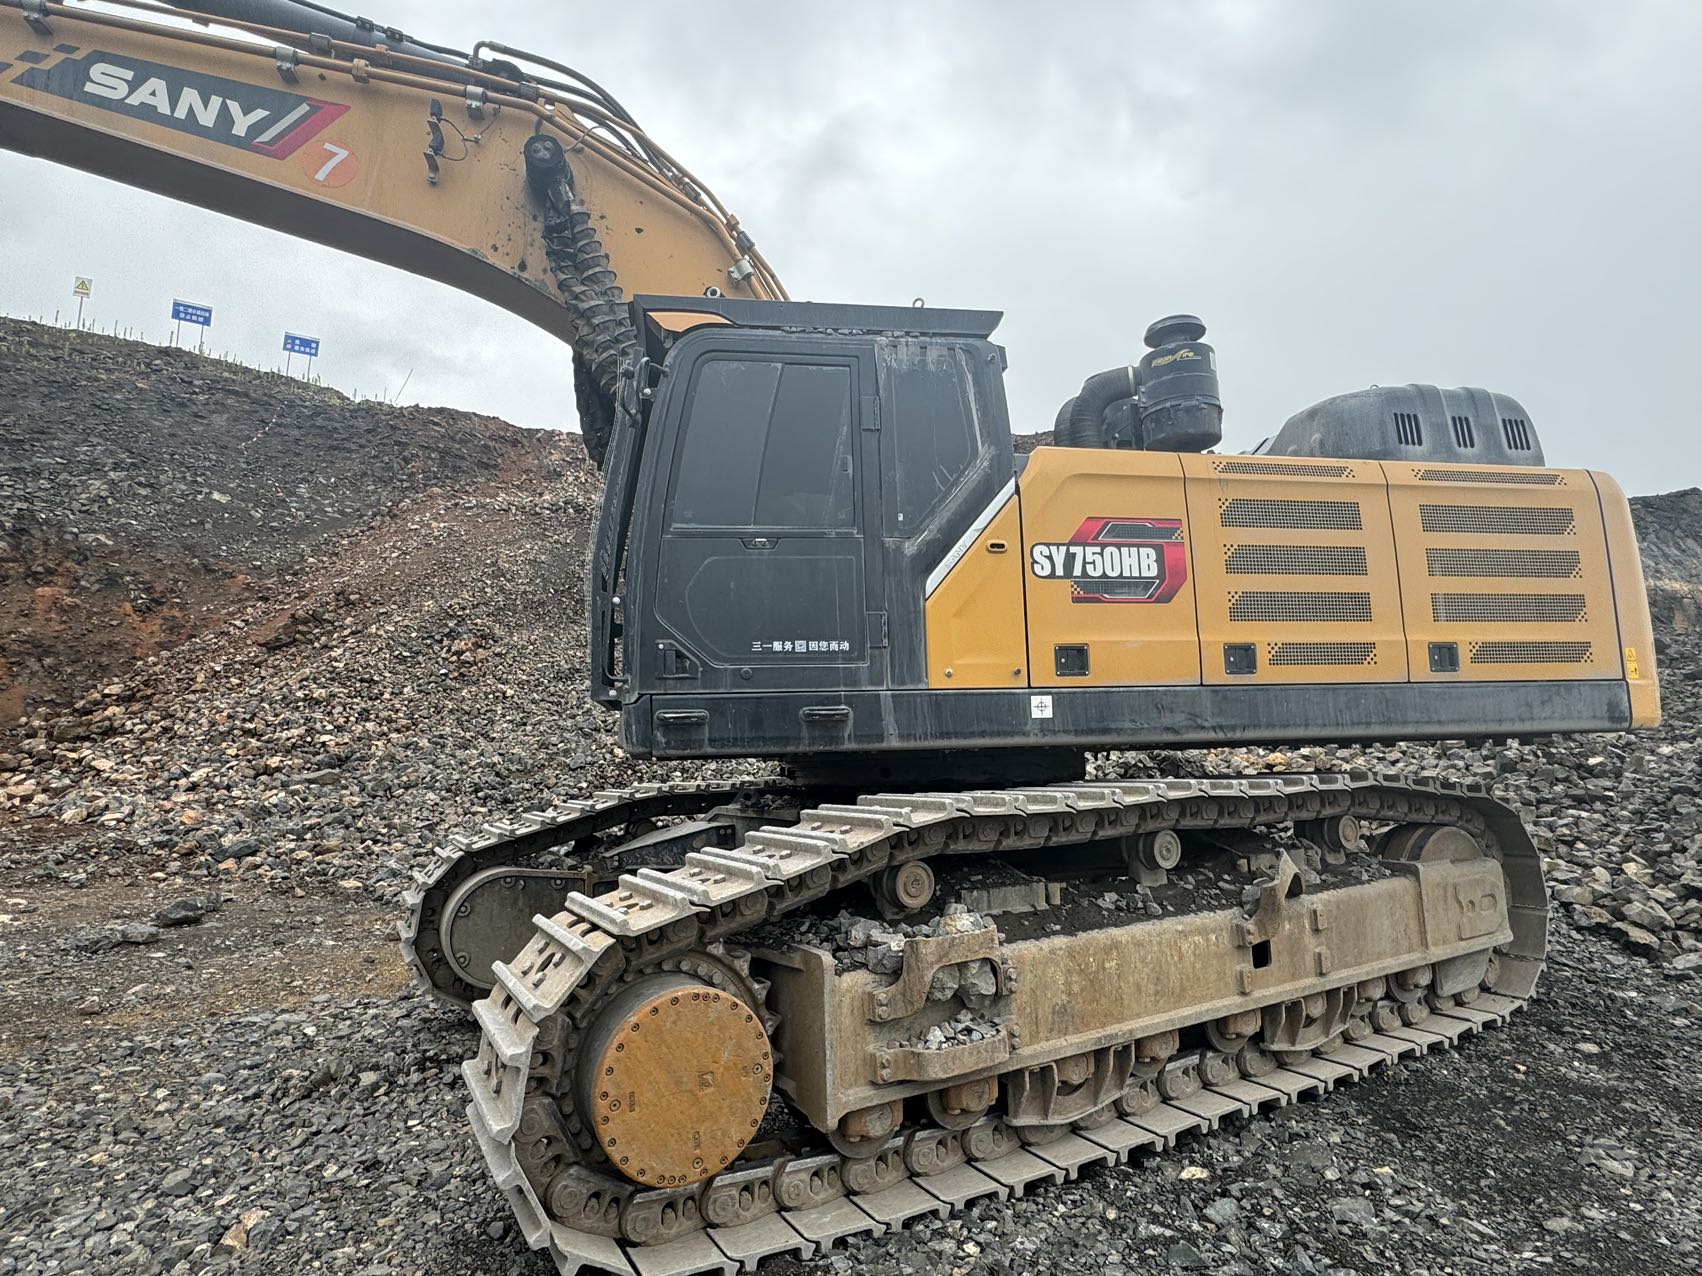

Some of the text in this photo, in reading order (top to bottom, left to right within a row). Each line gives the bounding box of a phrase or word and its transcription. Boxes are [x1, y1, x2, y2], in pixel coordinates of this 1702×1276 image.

[84, 62, 271, 138] SANY
[314, 142, 349, 182] 7
[945, 540, 968, 569] SANY
[1032, 544, 1158, 578] SY750HB
[751, 640, 850, 652] 三一服务 因您而动
